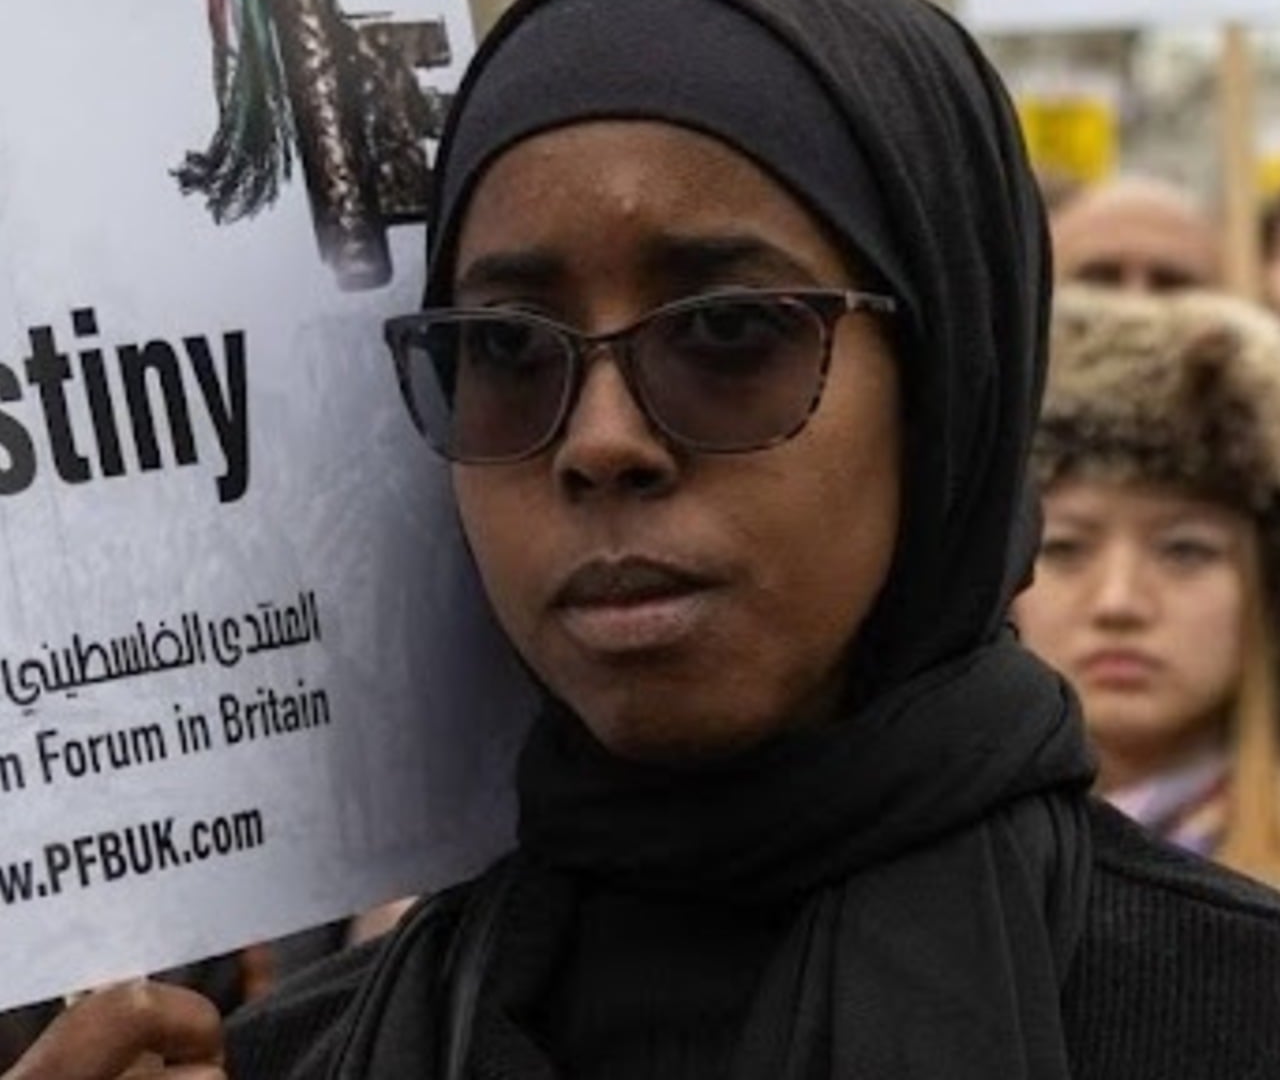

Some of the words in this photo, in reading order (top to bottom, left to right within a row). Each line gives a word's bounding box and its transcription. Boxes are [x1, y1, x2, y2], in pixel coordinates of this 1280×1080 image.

[1, 612, 207, 716] الفلسطيني
[35, 726, 168, 784] Forum
[174, 703, 212, 755] in
[219, 679, 332, 747] Britain
